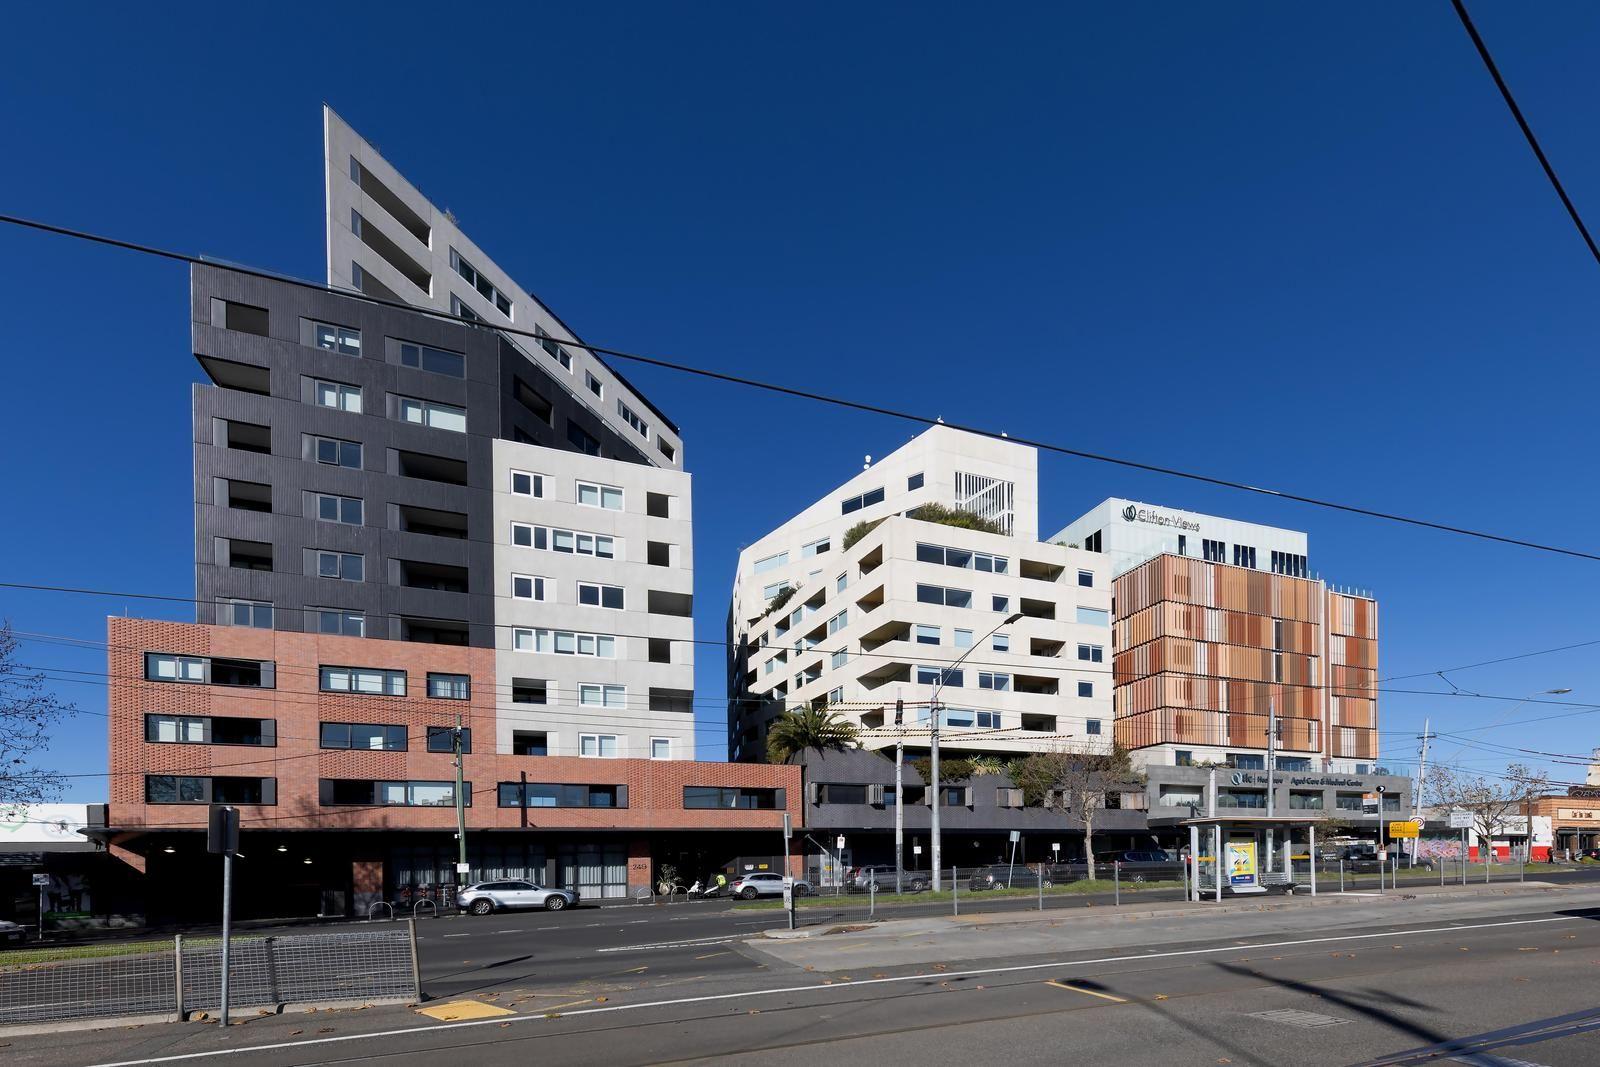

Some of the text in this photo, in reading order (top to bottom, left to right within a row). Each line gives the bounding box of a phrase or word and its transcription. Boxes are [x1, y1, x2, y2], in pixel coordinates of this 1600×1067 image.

[1137, 509, 1200, 532] Clifton Views
[1291, 776, 1306, 786] Aged
[1306, 777, 1320, 785] Care
[1325, 778, 1346, 786] Medical
[1346, 779, 1363, 787] Centre
